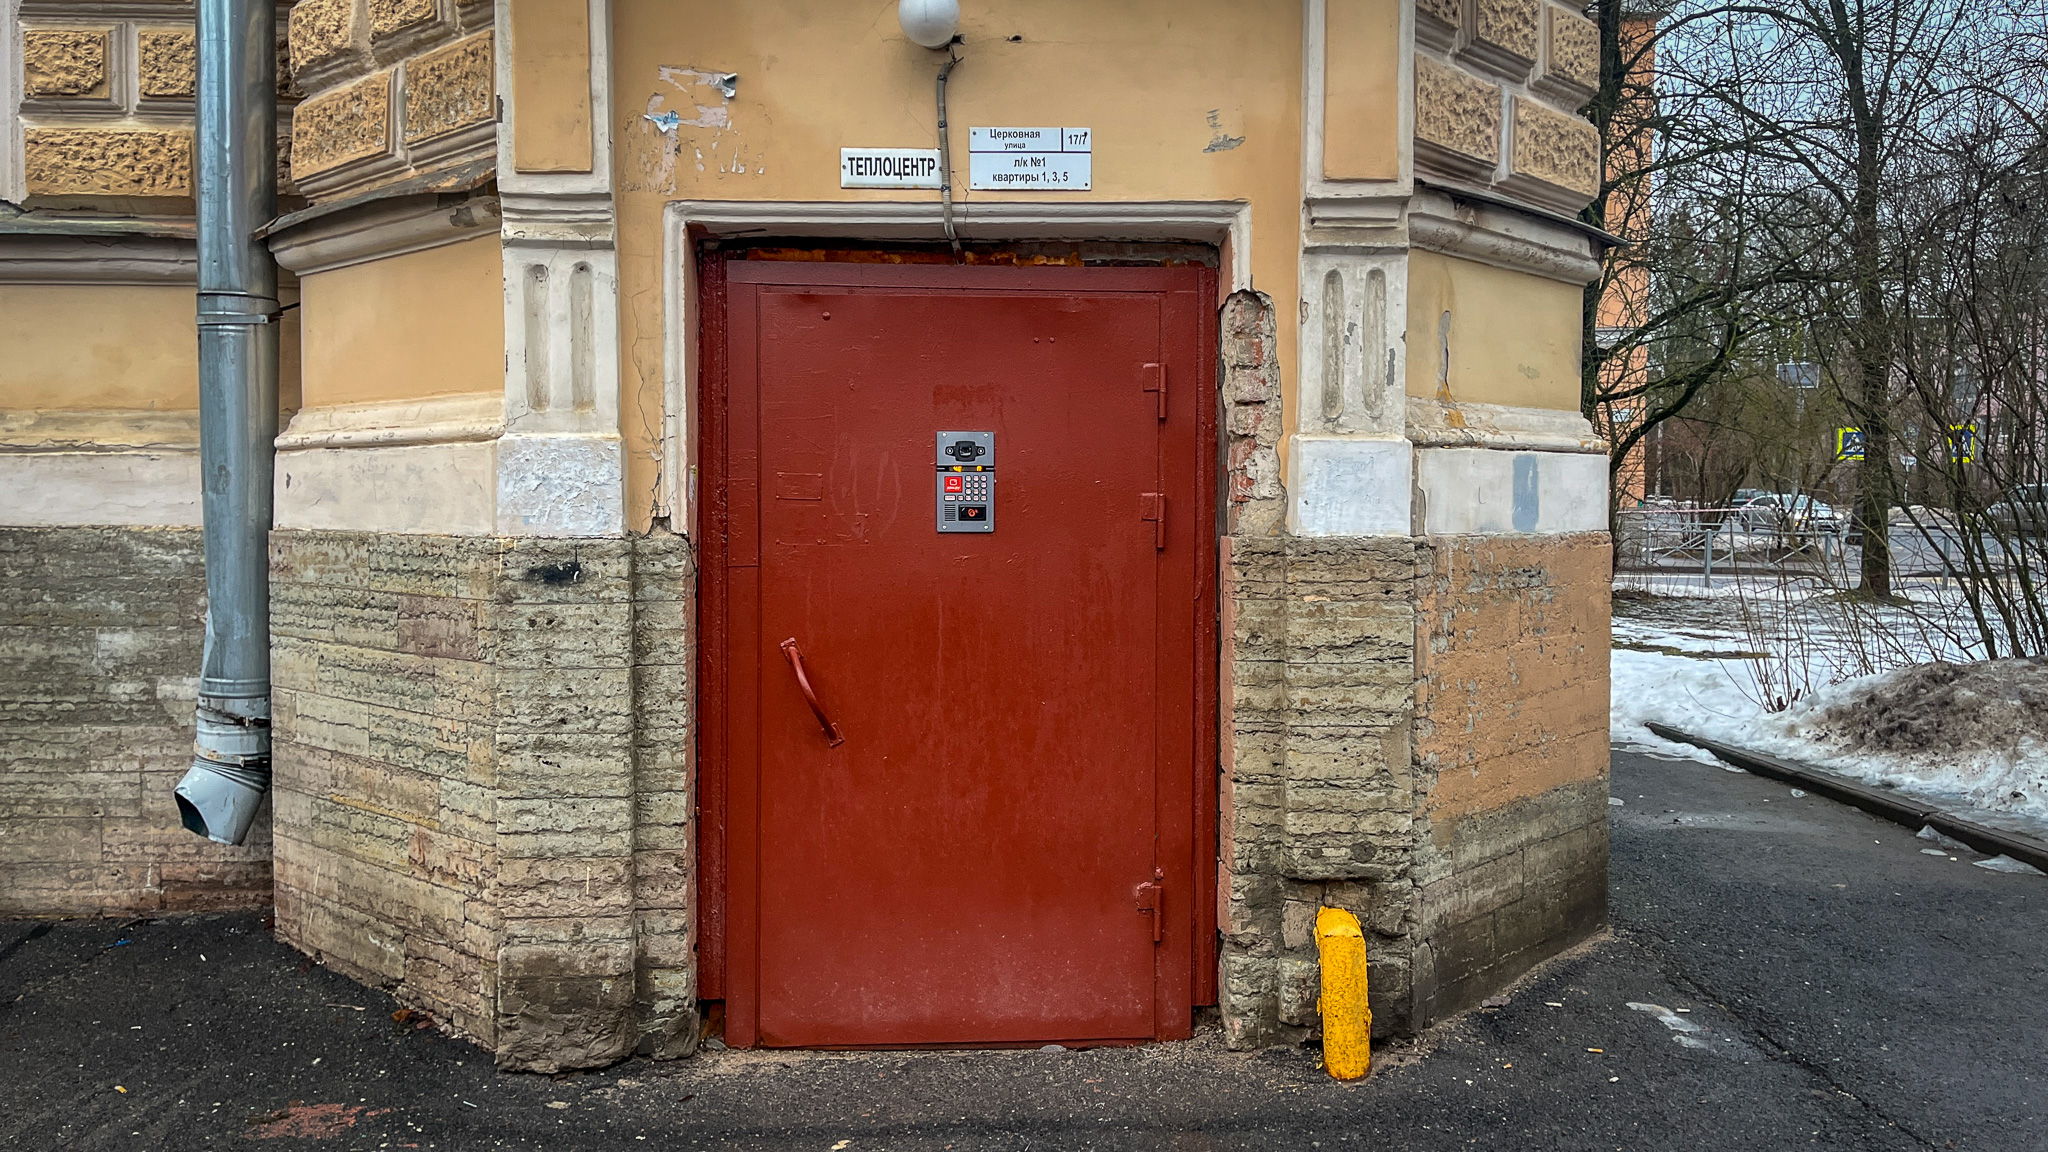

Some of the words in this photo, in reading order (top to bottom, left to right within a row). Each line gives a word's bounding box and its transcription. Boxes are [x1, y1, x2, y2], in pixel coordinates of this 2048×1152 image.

[990, 128, 1041, 140] Церковная
[1068, 134, 1088, 145] 17/7
[1004, 142, 1026, 150] улица
[1013, 157, 1028, 167] л/к
[1030, 157, 1046, 167] №1
[847, 156, 936, 180] ТЕПЛОЦЕНТР
[992, 173, 1039, 184] квартиры
[1041, 172, 1050, 183] 1,
[1052, 172, 1060, 183] 3,
[1062, 172, 1069, 182] 5
